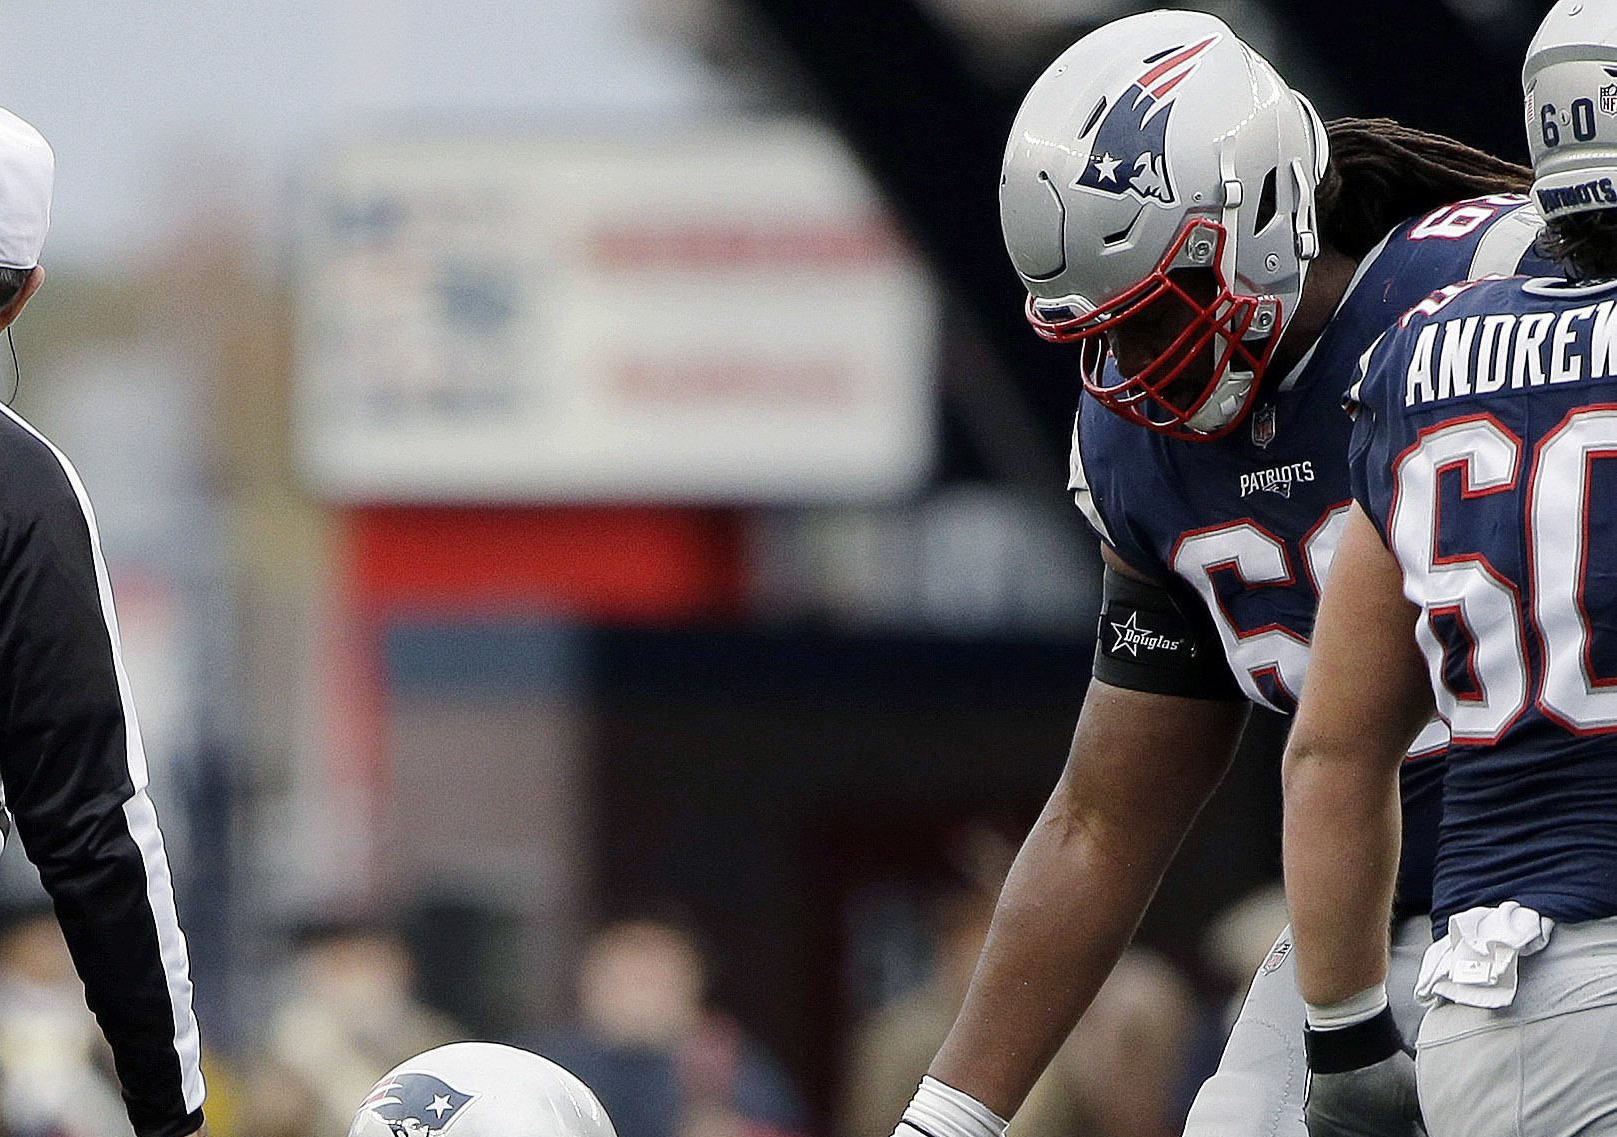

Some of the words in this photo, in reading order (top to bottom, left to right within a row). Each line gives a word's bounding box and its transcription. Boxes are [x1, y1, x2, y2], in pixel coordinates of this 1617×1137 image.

[1541, 98, 1596, 148] 60
[1240, 461, 1315, 497] PATRIOTS
[1385, 402, 1617, 746] 60
[1123, 628, 1180, 650] Douglas
